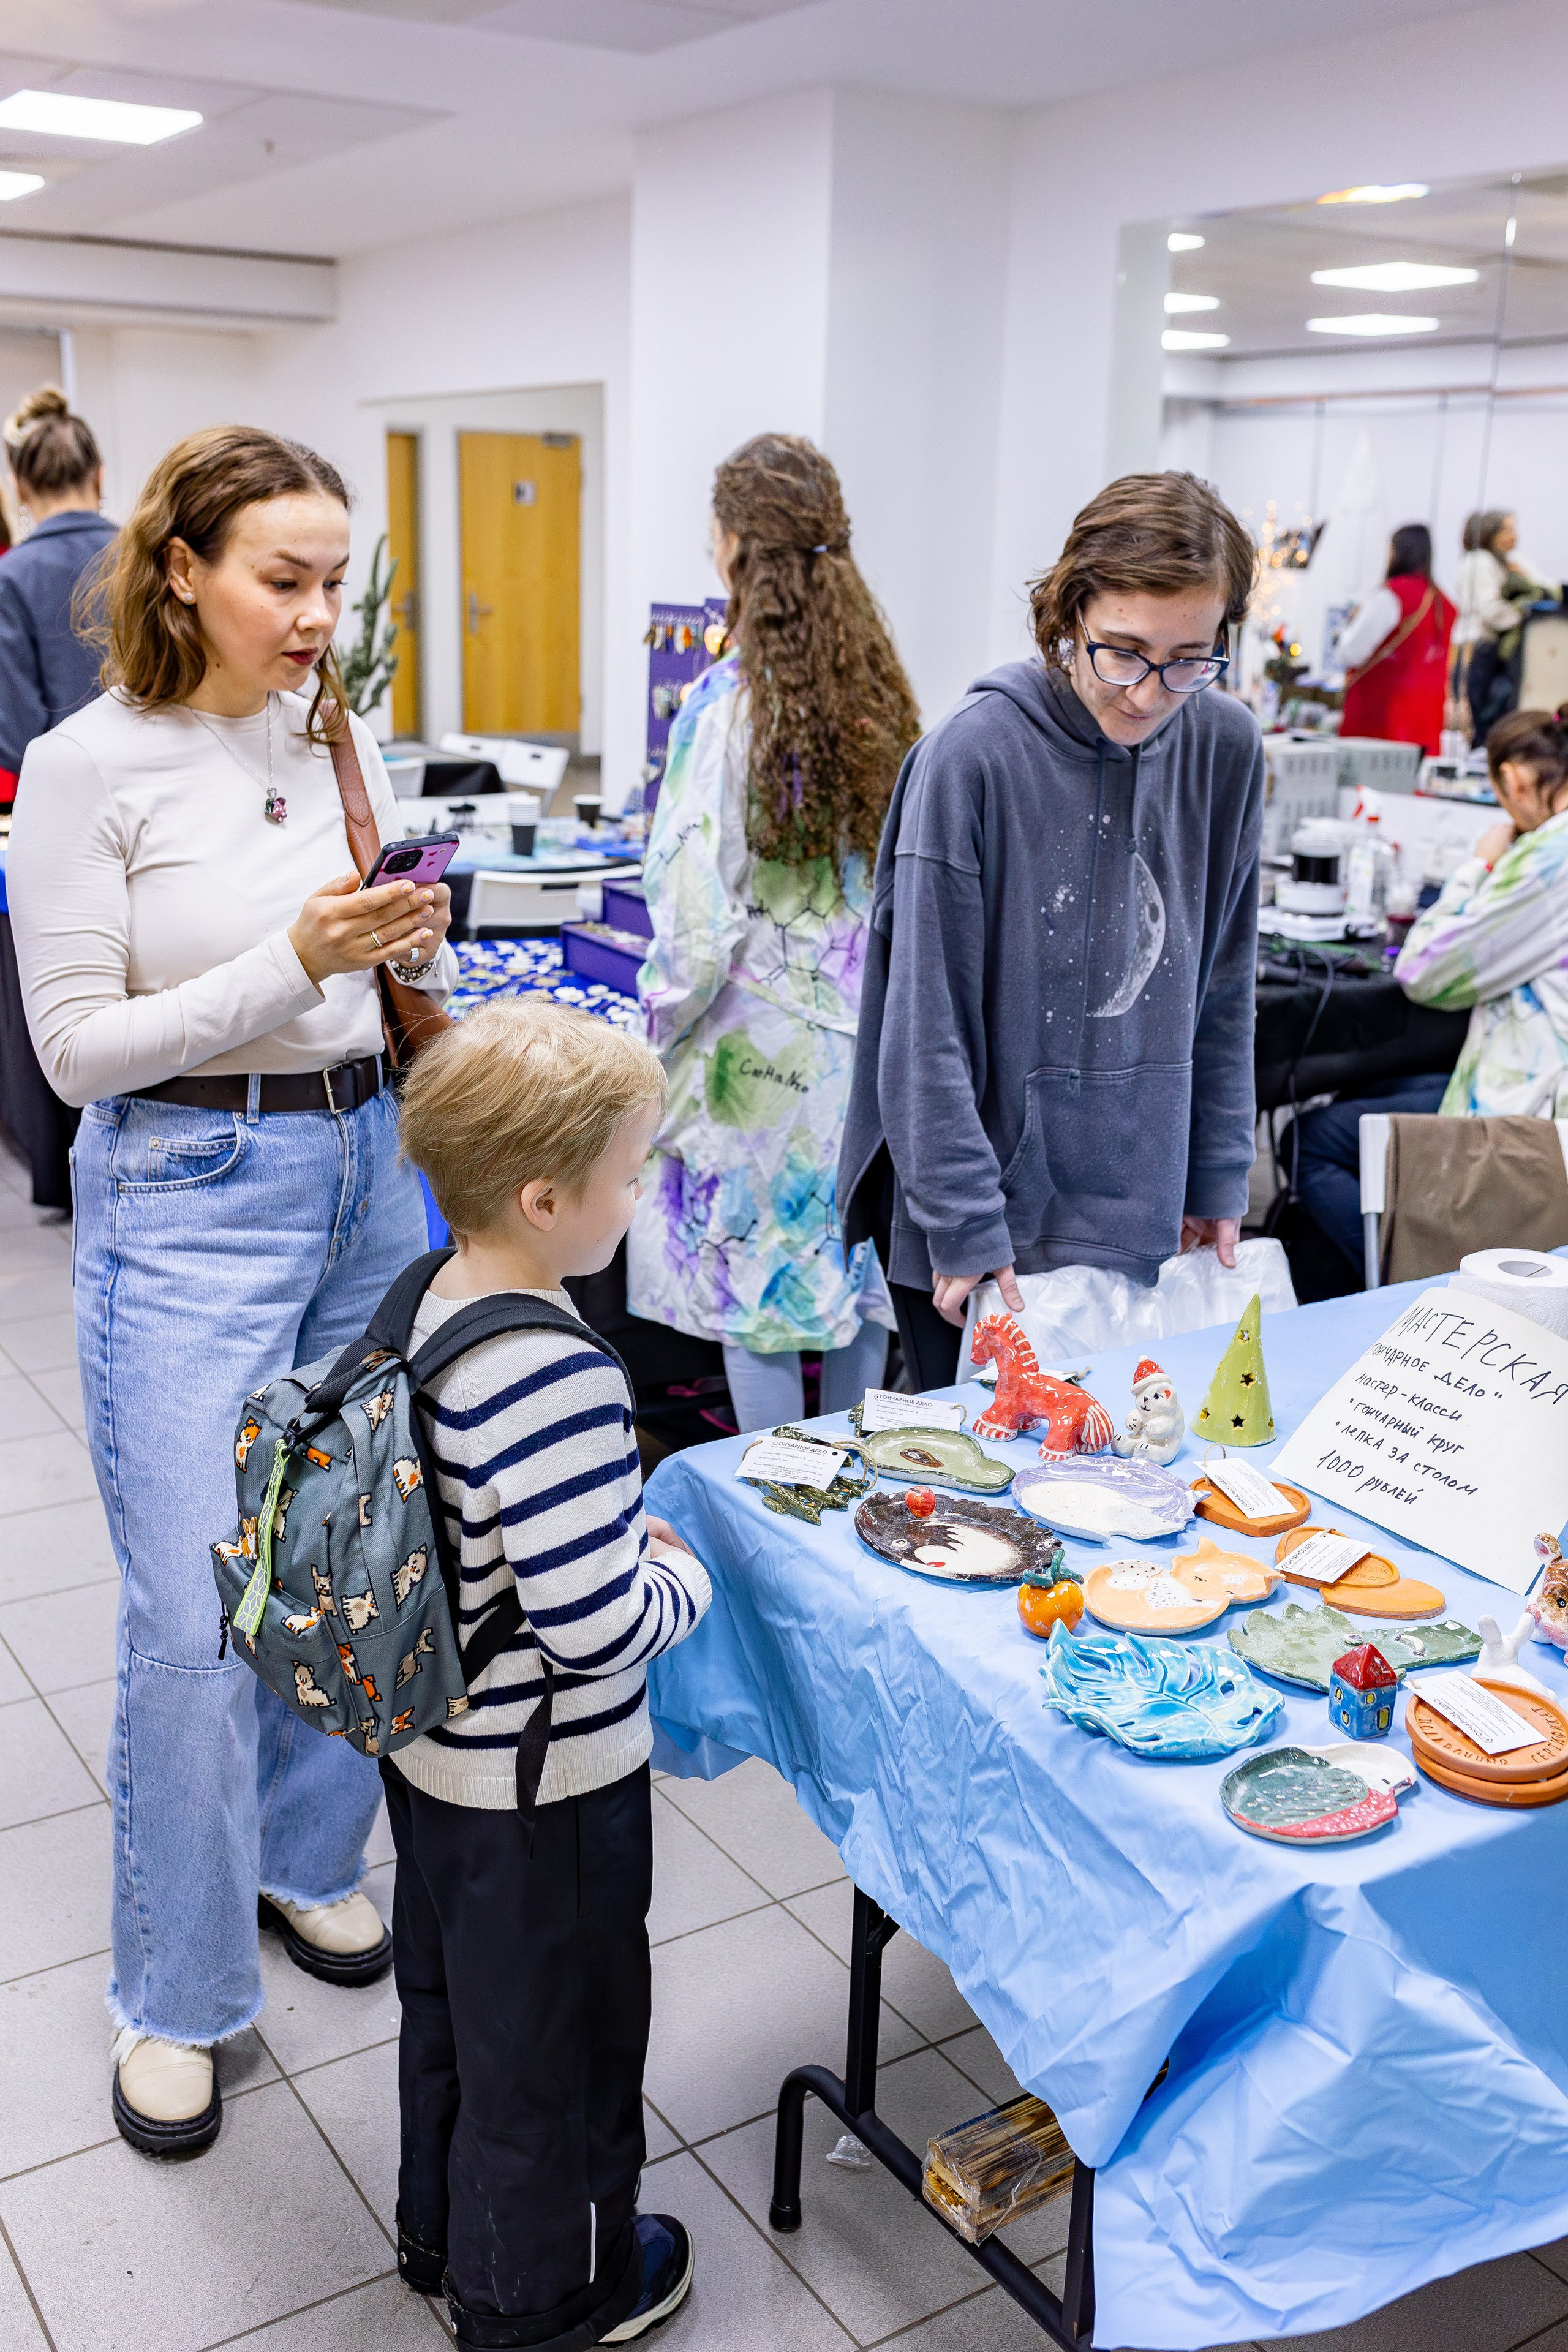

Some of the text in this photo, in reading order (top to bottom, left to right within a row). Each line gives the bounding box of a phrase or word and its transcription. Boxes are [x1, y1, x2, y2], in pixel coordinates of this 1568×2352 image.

[1387, 1305, 1568, 1404] МАСТЕРСКАЯ
[880, 1394, 914, 1404] ГОНЧАРНОЕ
[775, 1441, 810, 1451] ГОНЧАРНОЕ
[1317, 1449, 1364, 1478] 1000
